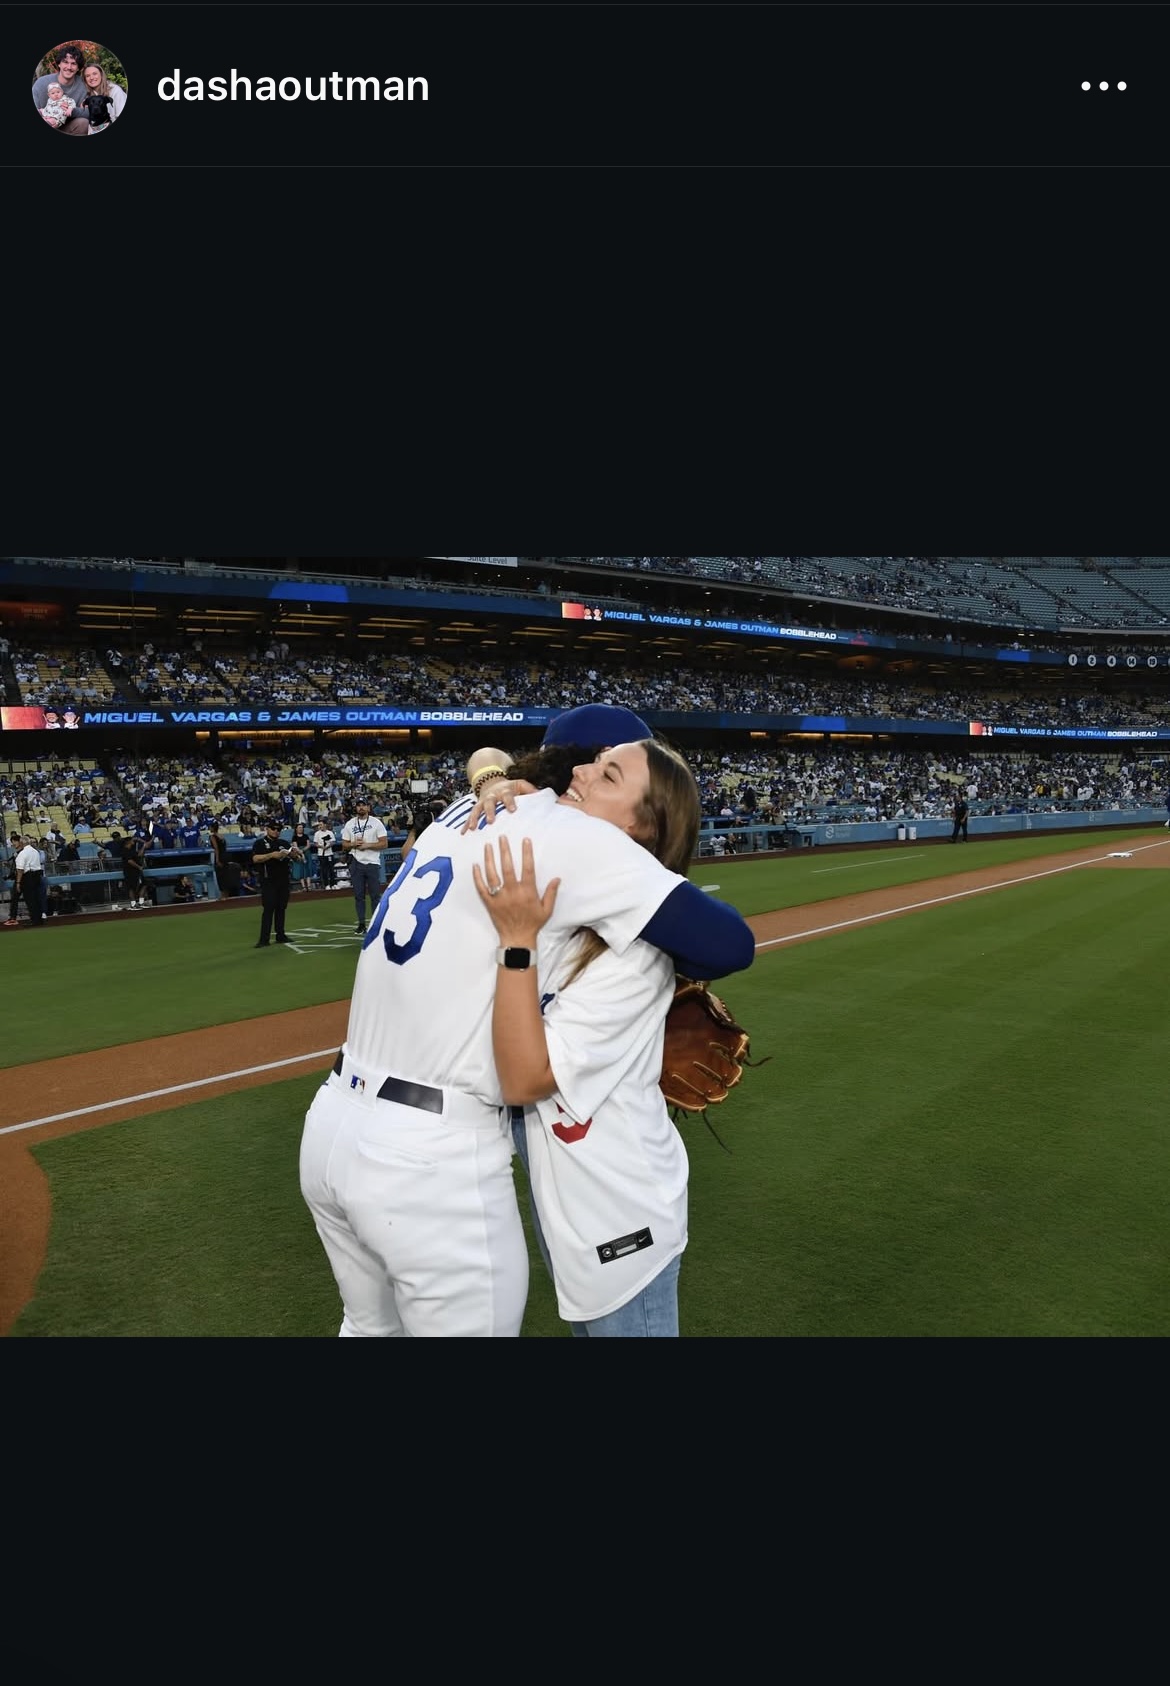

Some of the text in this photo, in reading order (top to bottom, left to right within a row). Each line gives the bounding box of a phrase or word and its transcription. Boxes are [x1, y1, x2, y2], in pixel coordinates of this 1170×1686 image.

[604, 610, 646, 621] MIGUEL
[649, 614, 691, 626] VARGAS
[694, 619, 702, 627] &
[704, 620, 738, 630] JAMES
[740, 623, 779, 635] OUTMAN
[780, 627, 837, 640] BOBBLEHEAD
[84, 712, 164, 723] MIGUEL
[171, 711, 252, 722] VARGAS
[257, 711, 271, 722] &
[277, 711, 341, 721] JAMES
[346, 711, 417, 721] OUTMAN
[420, 711, 524, 721] BOBBLEHEAD
[993, 726, 1018, 734] MIGUEL
[1053, 729, 1076, 737] JAMES
